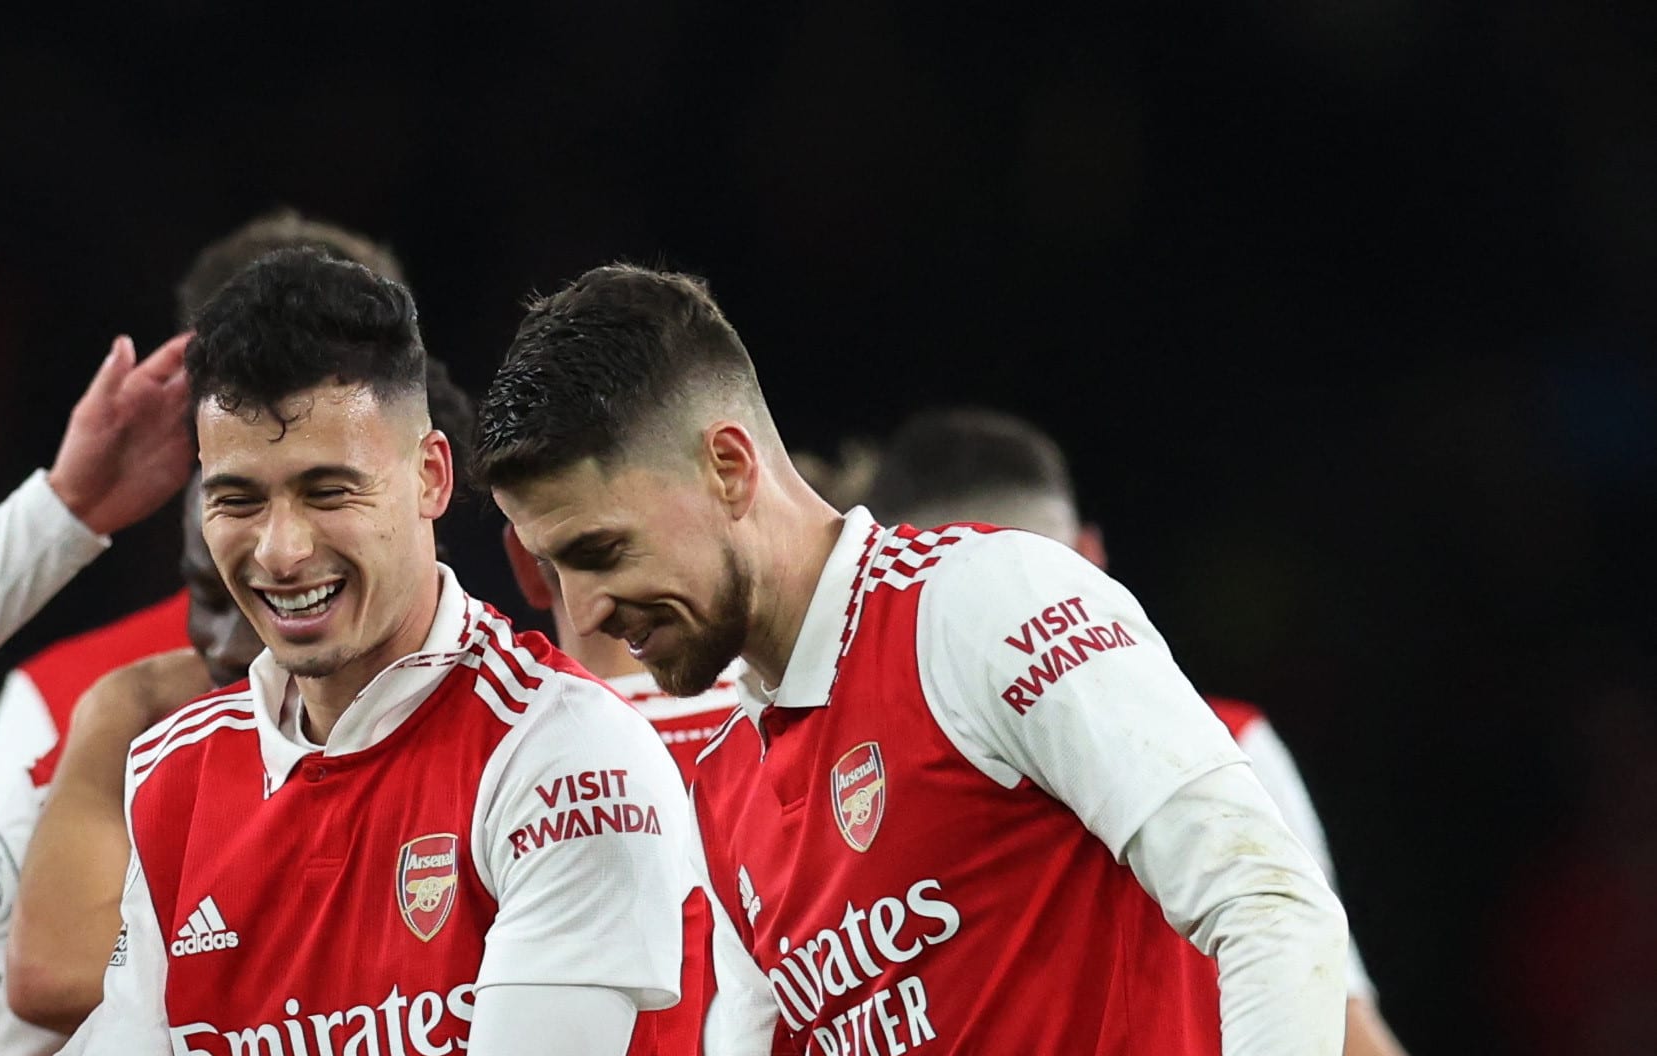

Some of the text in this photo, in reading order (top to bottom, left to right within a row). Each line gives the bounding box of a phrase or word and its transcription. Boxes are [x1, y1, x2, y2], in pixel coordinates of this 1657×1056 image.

[1003, 596, 1090, 656] VISIT
[1001, 621, 1138, 716] RWANDA
[534, 769, 628, 809] VISIT
[838, 755, 876, 792] Arsenal
[507, 803, 662, 860] RWANDA
[406, 848, 454, 870] Arsenal
[171, 929, 240, 957] adidas
[767, 878, 961, 1033] mirates
